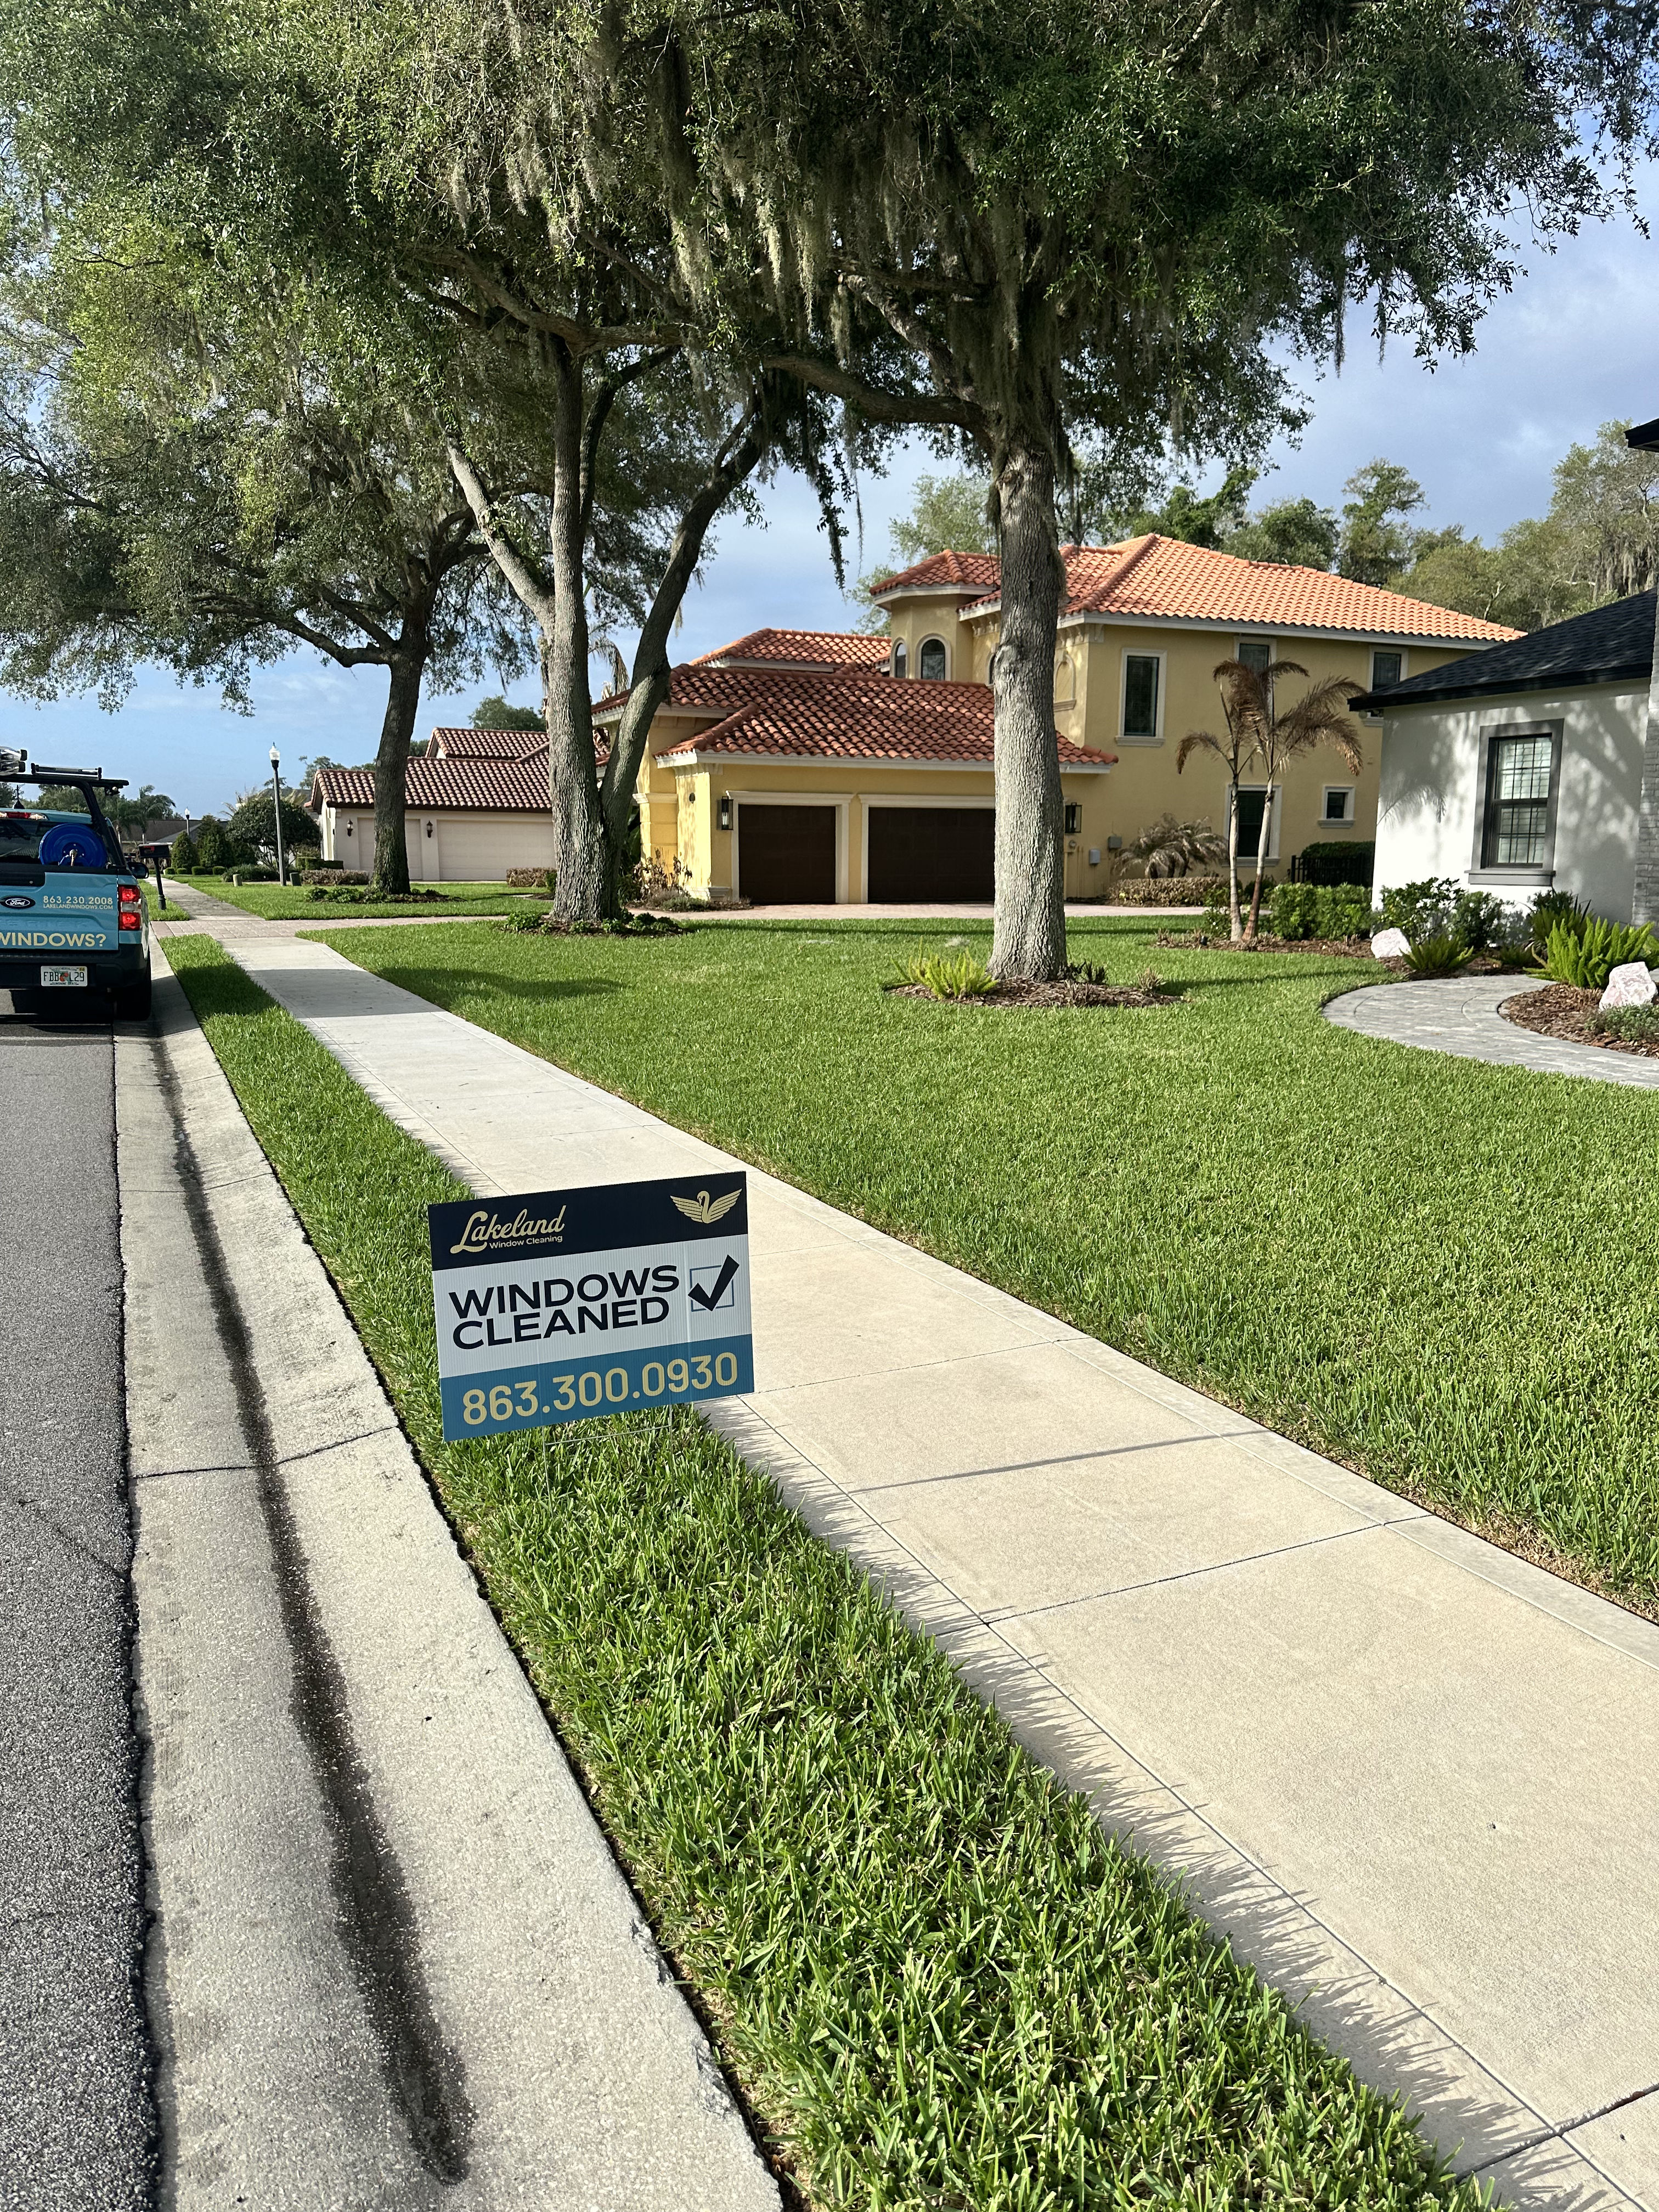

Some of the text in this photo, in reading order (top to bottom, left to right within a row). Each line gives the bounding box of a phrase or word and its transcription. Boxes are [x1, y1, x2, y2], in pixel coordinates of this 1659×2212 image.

[43, 895, 113, 905] 863.230.2008
[450, 1205, 566, 1254] Lakeland
[489, 1235, 563, 1249] Window Cleaning
[448, 1265, 680, 1319] WINDOWS
[453, 1296, 669, 1350] CLEANED
[462, 1352, 738, 1425] 863.300.0930
